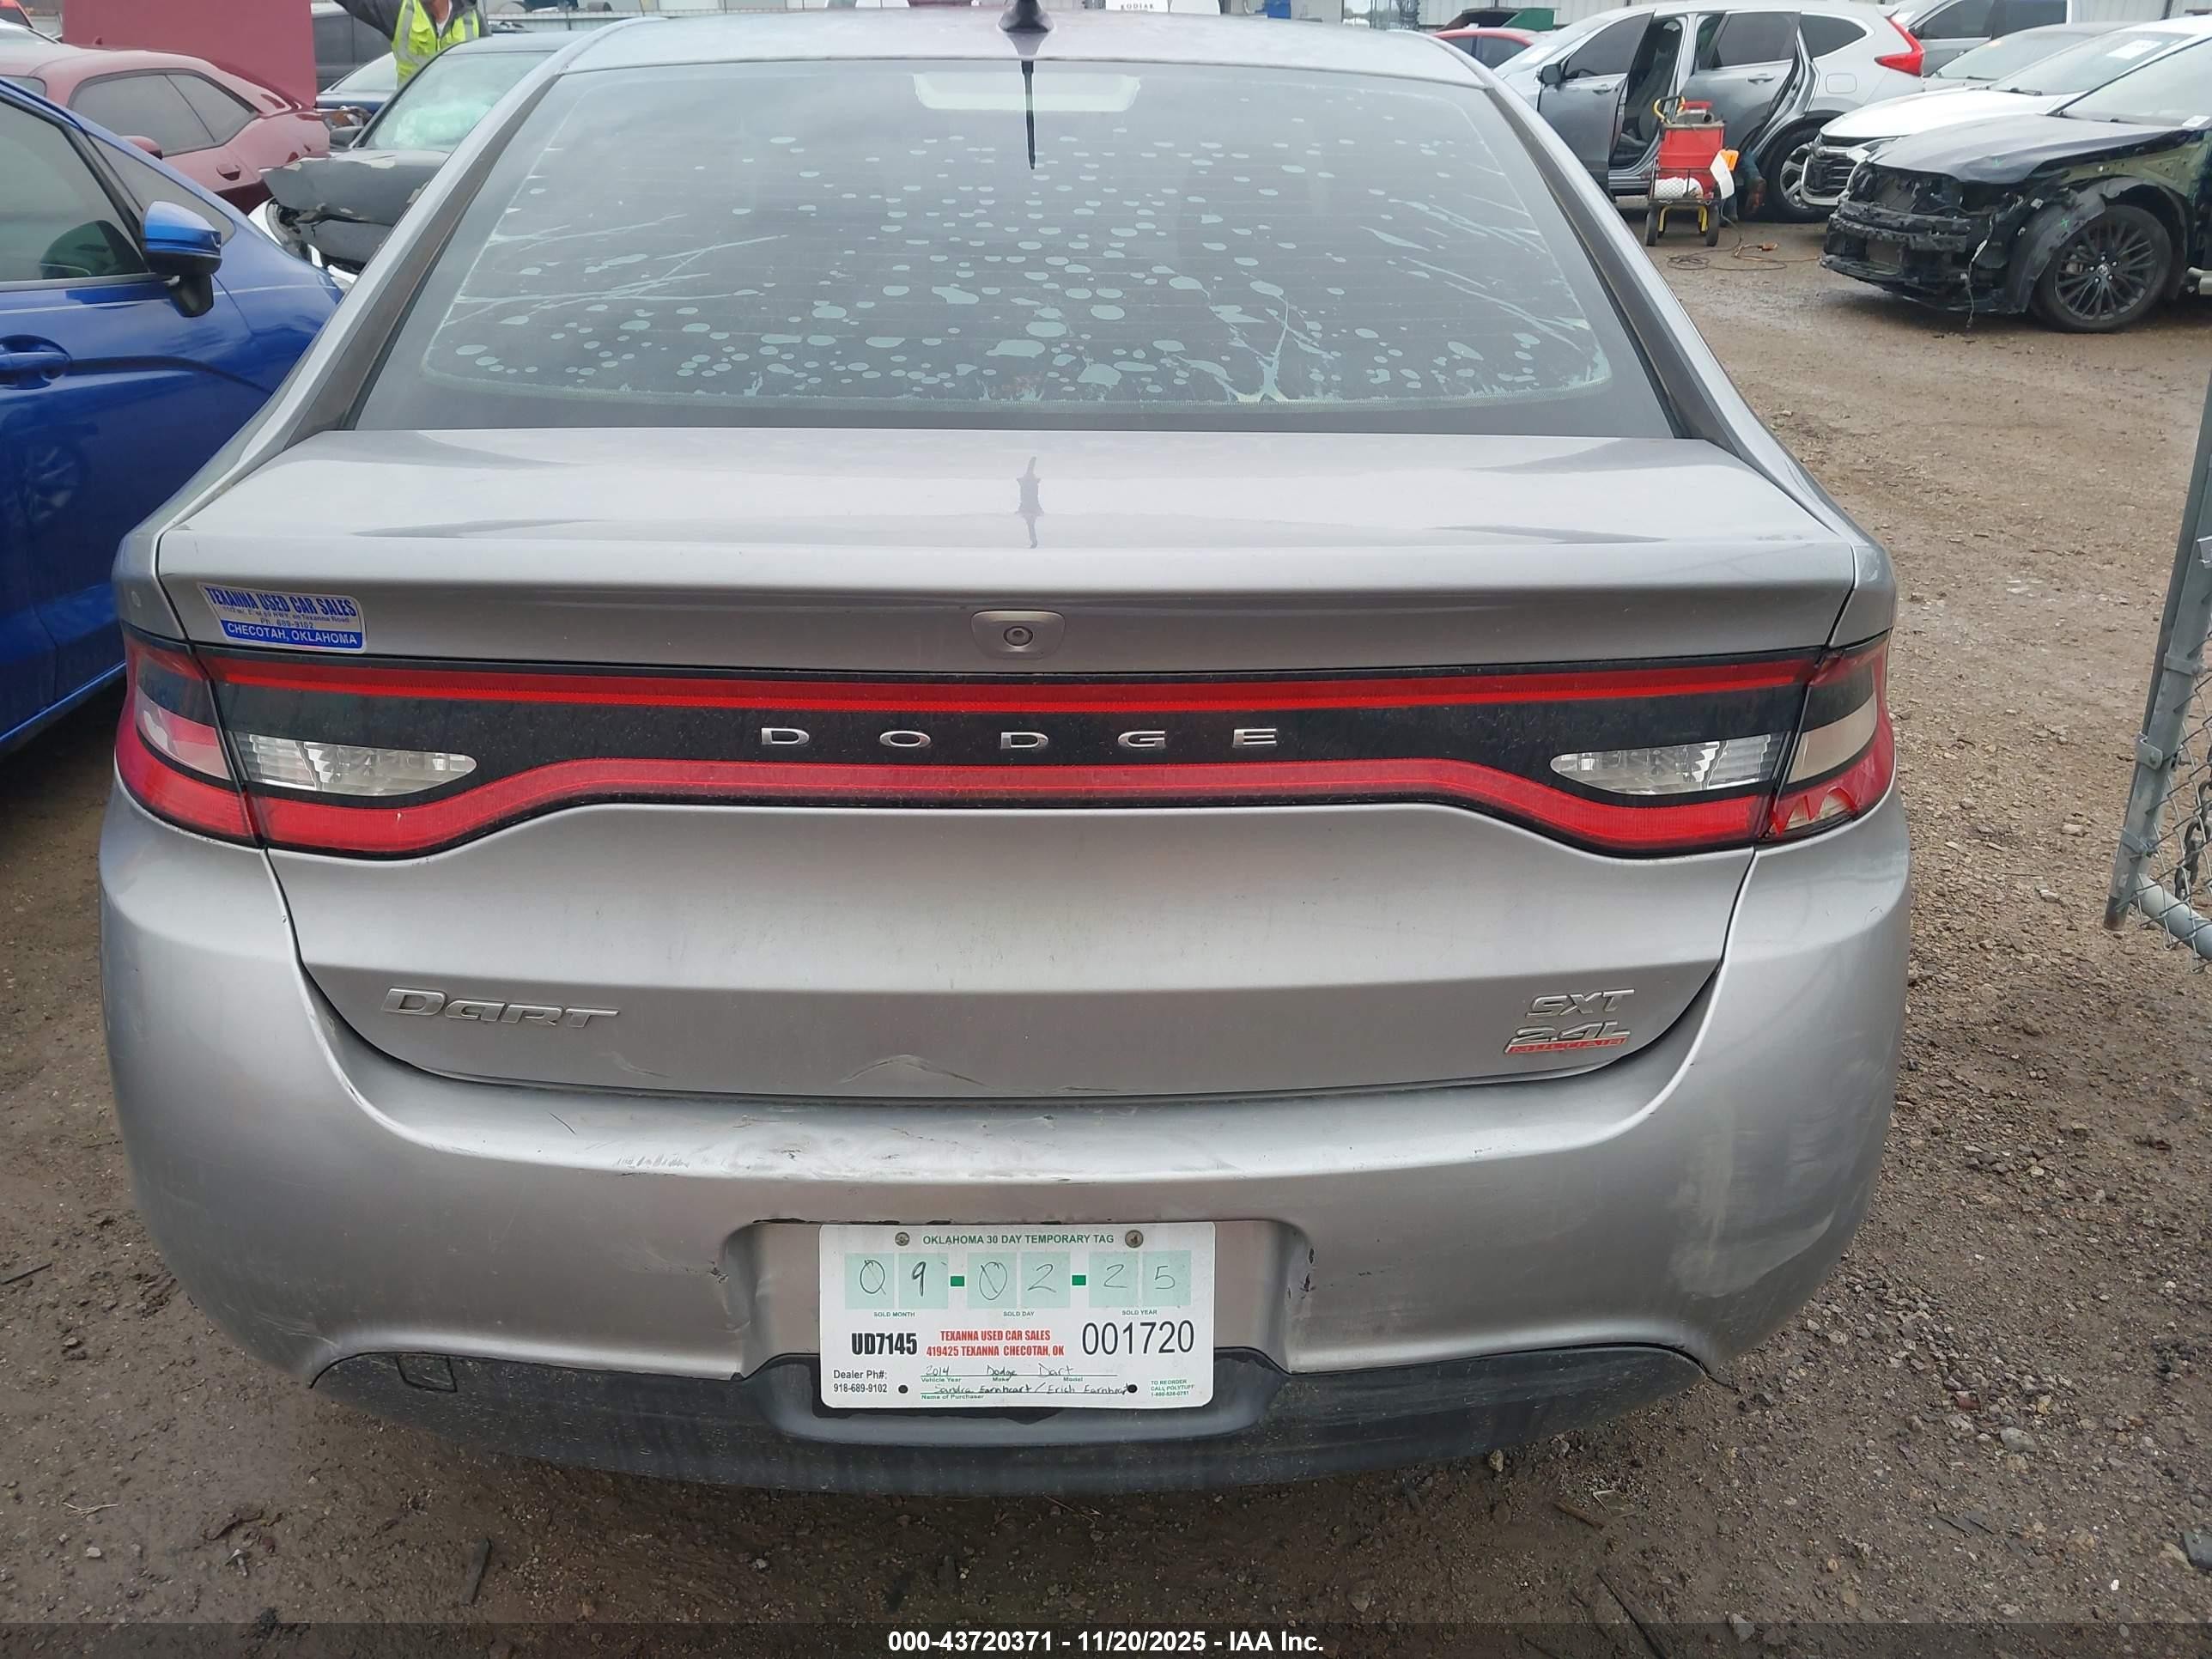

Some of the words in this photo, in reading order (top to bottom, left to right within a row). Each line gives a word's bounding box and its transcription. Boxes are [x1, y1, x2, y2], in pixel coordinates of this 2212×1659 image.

[205, 587, 258, 609] TEXANNA
[256, 593, 290, 611] USED
[289, 596, 318, 614] CAR
[316, 598, 356, 617] SALES
[228, 623, 289, 641] CHECOTAH,
[292, 629, 358, 644] OKLAHOMA
[761, 726, 1278, 750] DODGE
[1525, 988, 1635, 1018] SXT
[923, 1235, 984, 1244] OKLAHOMA
[987, 1235, 999, 1243] 30
[1001, 1235, 1022, 1243] DAY
[1024, 1234, 1091, 1243] TEMPORARY
[1092, 1234, 1114, 1243] TAG
[940, 1330, 979, 1341] TEXANNA
[981, 1330, 1003, 1341] USED
[1005, 1330, 1022, 1341] CAR
[1024, 1330, 1051, 1341] SALES
[1082, 1320, 1194, 1355] 001720
[852, 1333, 917, 1355] UD7145
[926, 1346, 959, 1357] 419425
[961, 1346, 1000, 1357] TEXANNA
[1003, 1346, 1050, 1357] CHECOTAH,
[1052, 1346, 1065, 1356] OK
[833, 1370, 864, 1379] Dealer
[866, 1370, 888, 1379] Ph#:
[925, 1364, 951, 1376] 2014
[987, 1364, 1018, 1379] Dodge
[1037, 1363, 1074, 1377] Dart
[833, 1383, 888, 1393] 918-689-9102
[934, 1385, 974, 1394] Sandra
